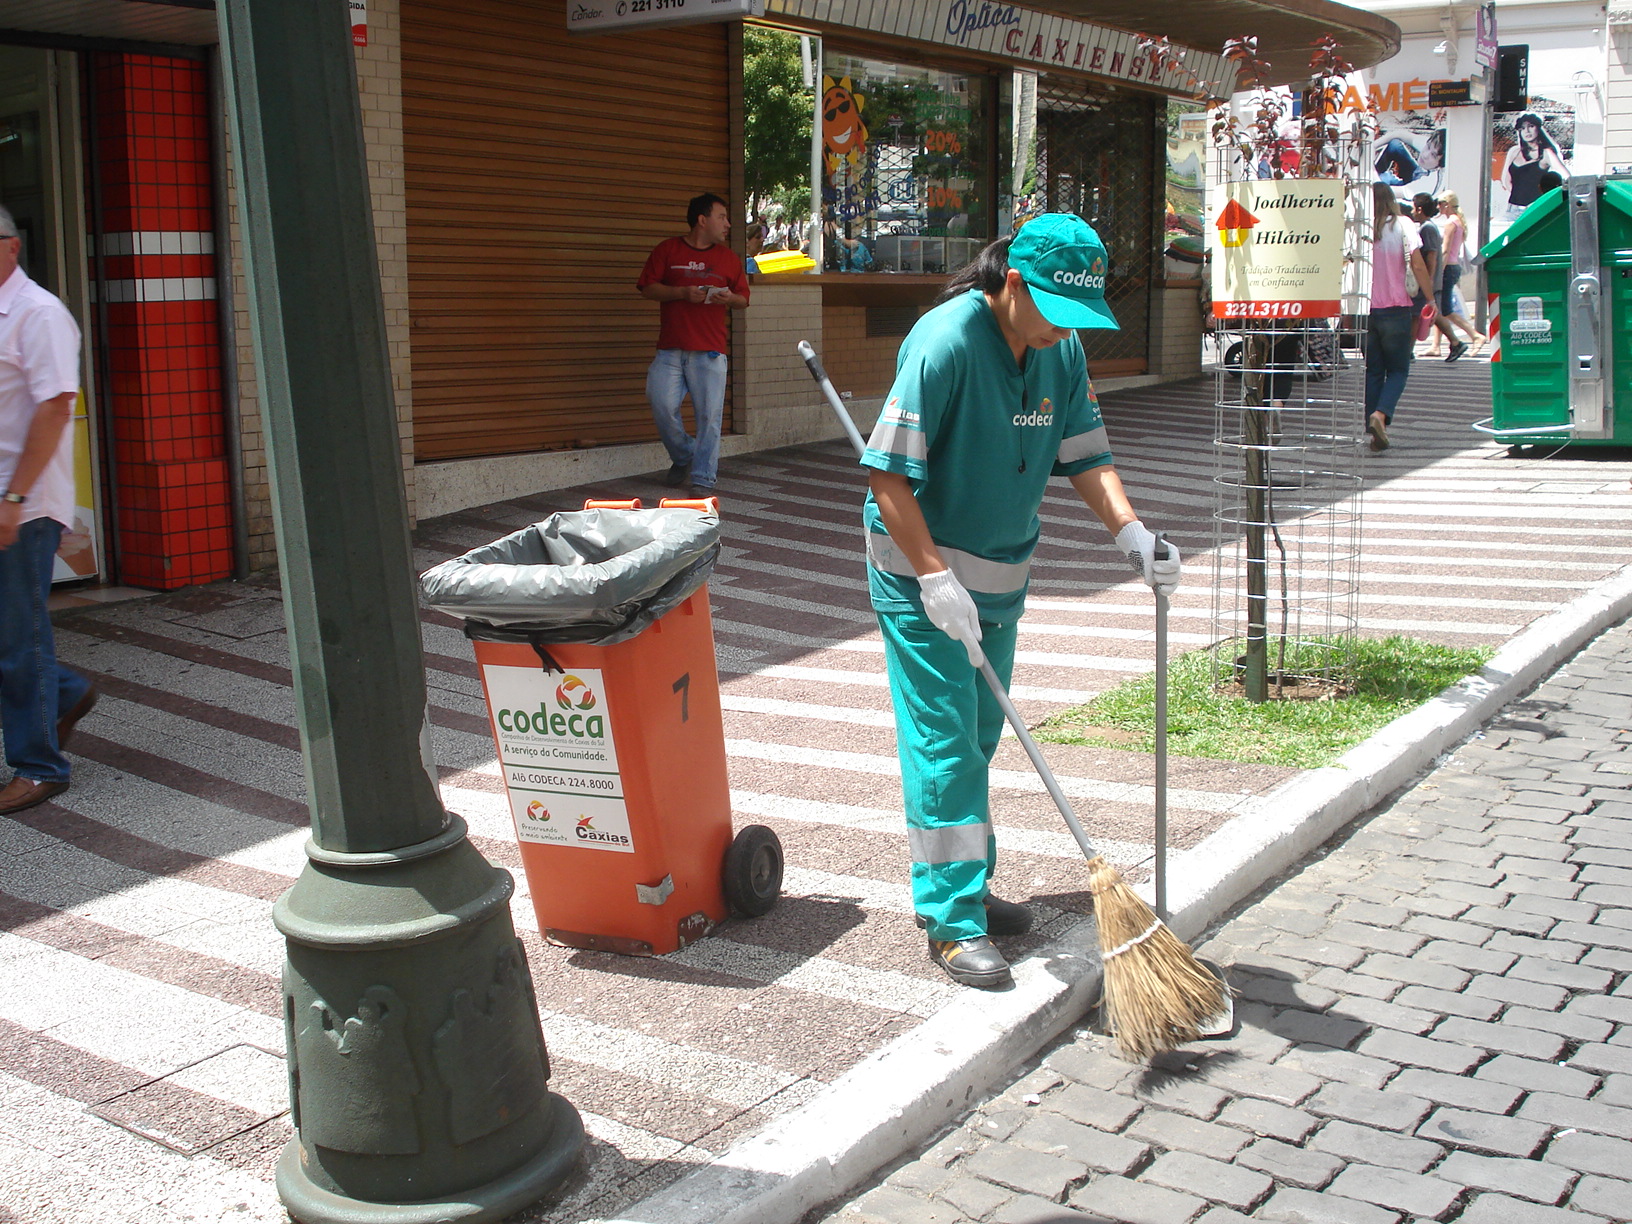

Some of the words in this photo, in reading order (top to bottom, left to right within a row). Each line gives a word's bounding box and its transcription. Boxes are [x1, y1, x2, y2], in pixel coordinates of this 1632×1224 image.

[631, 1, 651, 13] 221
[1005, 29, 1163, 81] CAXIENSE
[925, 130, 961, 153] 20%
[927, 187, 962, 208] 10%
[1254, 193, 1335, 212] Joalheria
[1255, 229, 1321, 245] Hilário
[1275, 264, 1320, 275] Traduzida
[1261, 278, 1305, 289] Confiança
[1225, 302, 1303, 317] 3221.3110
[1012, 410, 1053, 427] codeca
[498, 702, 604, 738] codeca
[504, 743, 510, 753] A
[511, 746, 539, 759] serviço
[540, 747, 551, 757] da
[552, 748, 608, 762] Comunidade.
[512, 772, 527, 783] Alô
[528, 774, 566, 786] CODECA
[567, 778, 614, 790] 224.8000
[575, 826, 629, 844] Caxias
